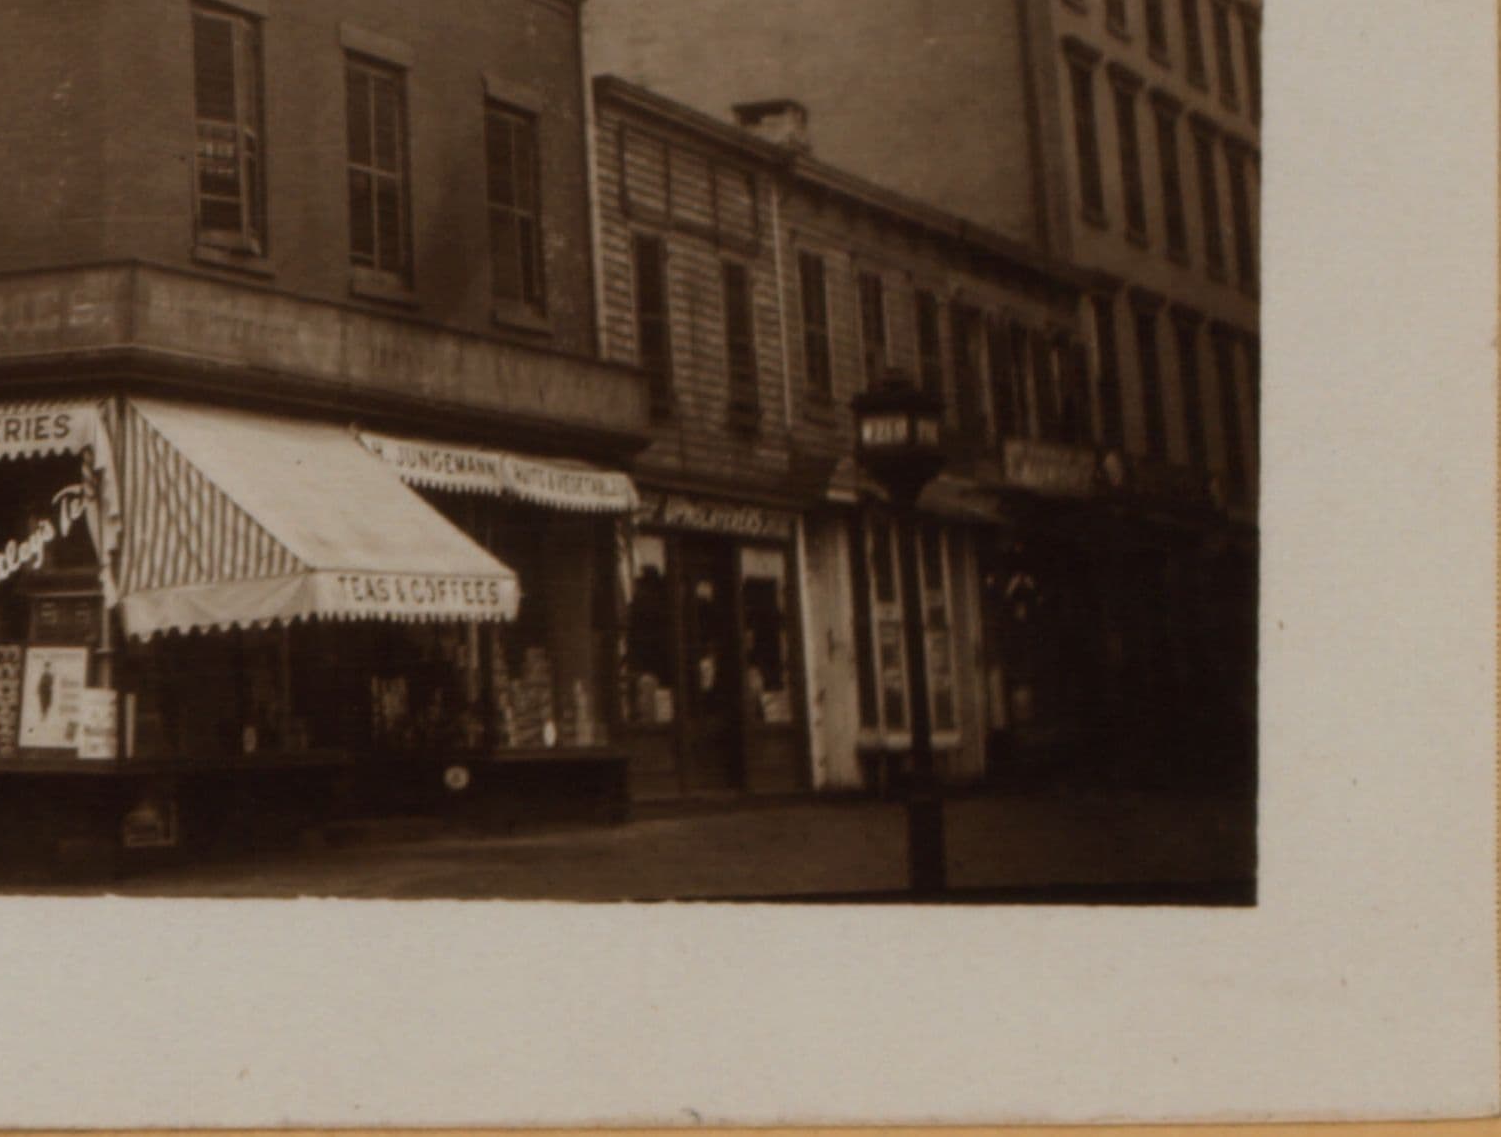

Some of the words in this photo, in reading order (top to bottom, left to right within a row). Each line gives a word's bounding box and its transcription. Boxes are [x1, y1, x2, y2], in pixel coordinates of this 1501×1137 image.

[50, 482, 87, 538] Te
[337, 575, 391, 604] TEAS
[410, 579, 501, 607] COFFEES
